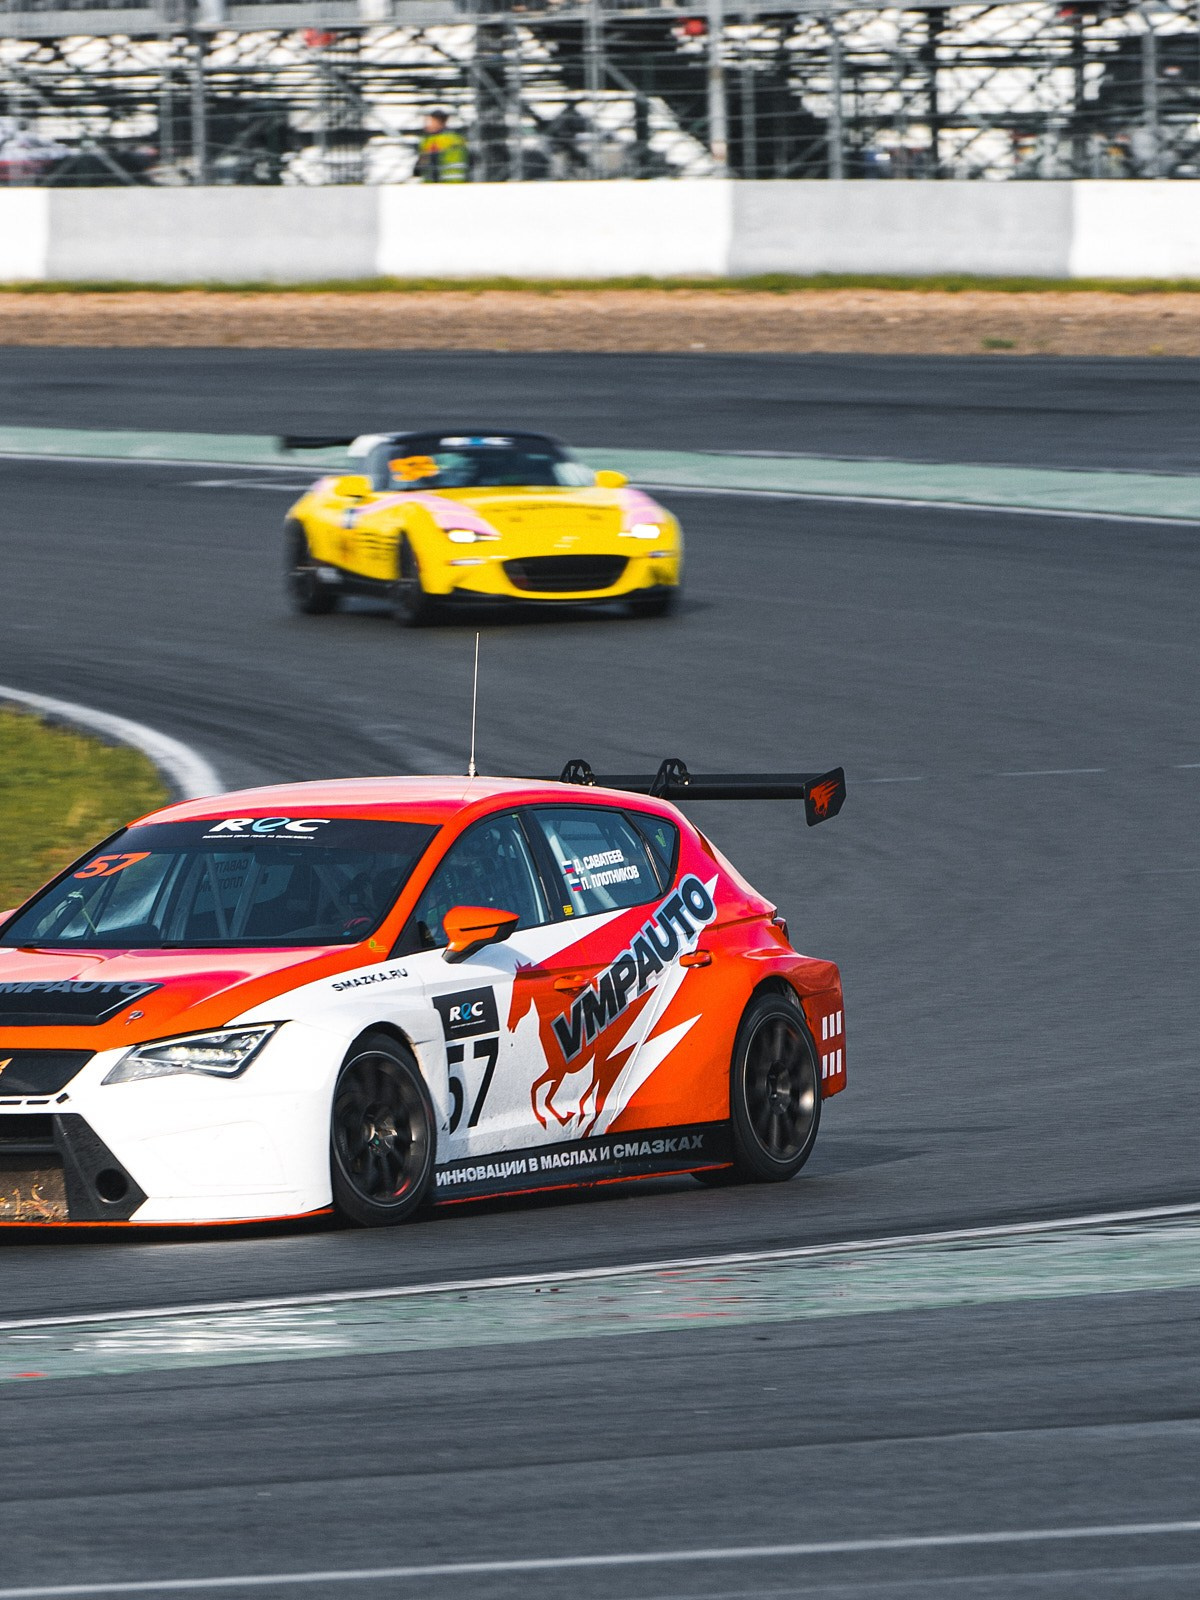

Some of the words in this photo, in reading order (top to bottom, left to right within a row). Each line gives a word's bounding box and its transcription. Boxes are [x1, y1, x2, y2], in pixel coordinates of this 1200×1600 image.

[73, 851, 152, 879] 57
[573, 858, 585, 875] Д.
[583, 849, 624, 870] САВАТЕЕВ
[581, 876, 592, 890] П.
[590, 865, 640, 888] ПЛОТНИКОВ
[331, 968, 408, 991] SMAZKA.RU
[551, 874, 717, 1063] VMPAUTO
[435, 1159, 526, 1187] ИННОВАЦИИ
[528, 1157, 538, 1172] В
[540, 1148, 597, 1169] МАСЛАХ
[600, 1146, 610, 1161] И
[613, 1134, 704, 1159] СМАЗКАХ
